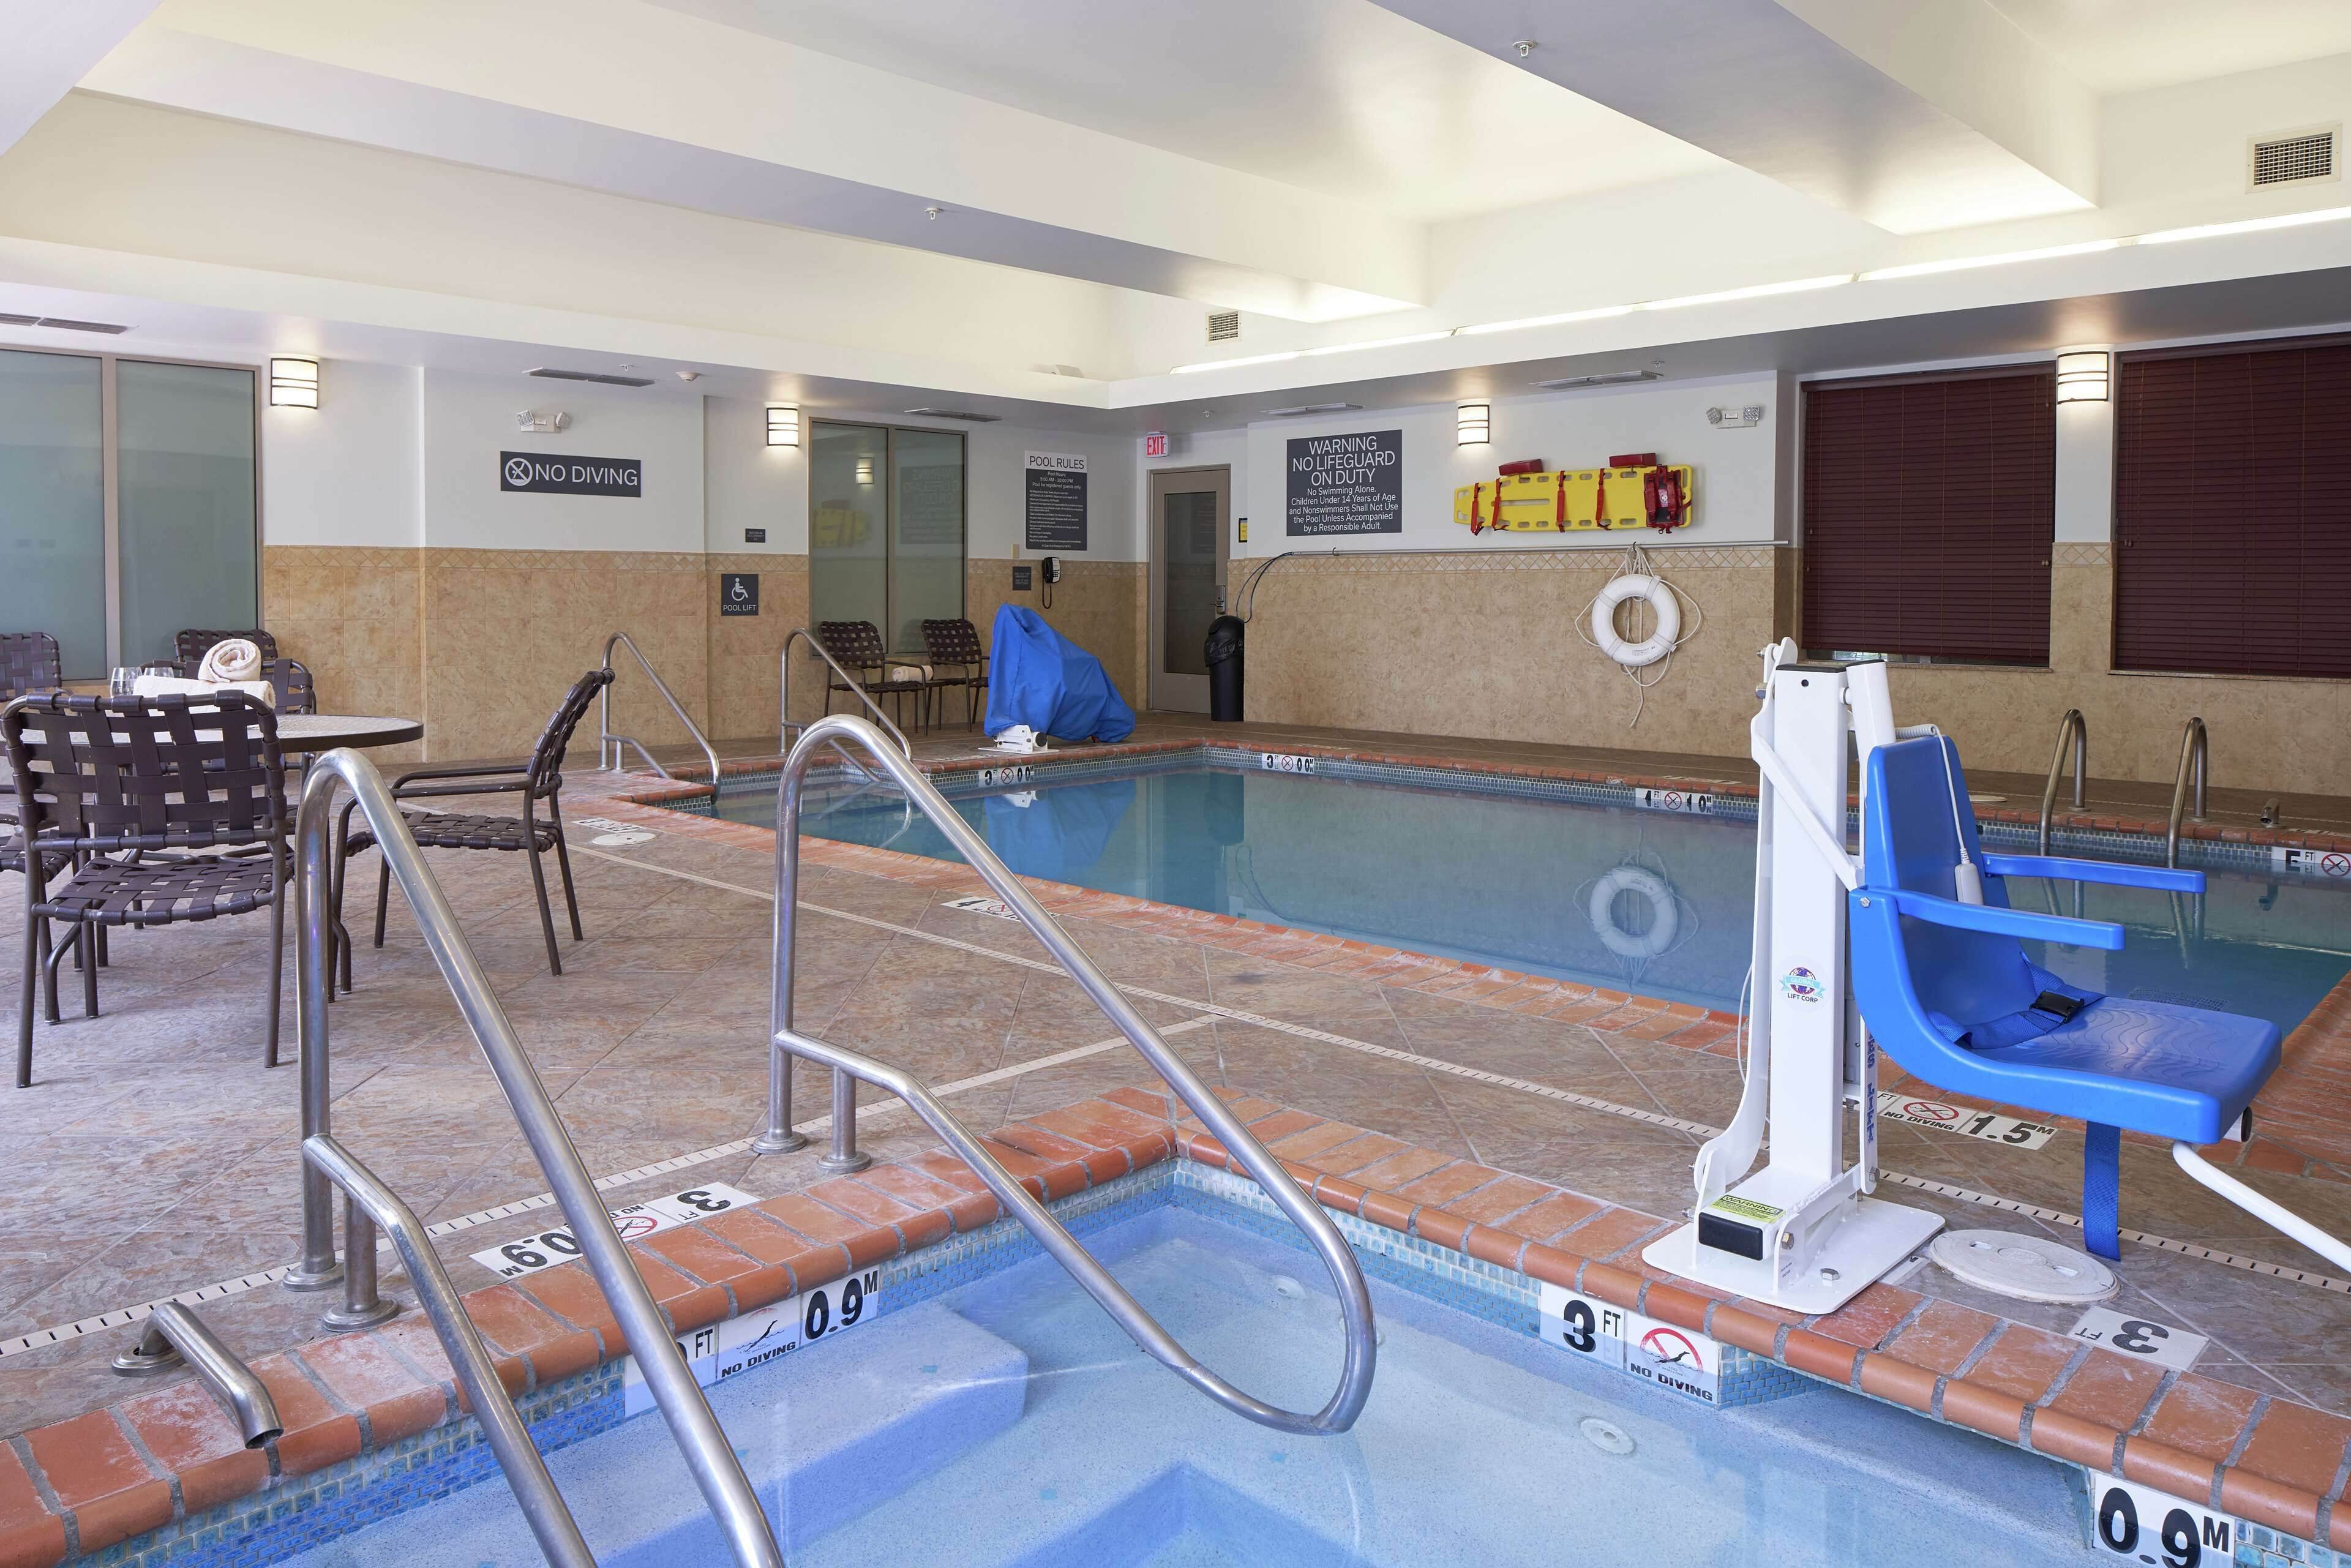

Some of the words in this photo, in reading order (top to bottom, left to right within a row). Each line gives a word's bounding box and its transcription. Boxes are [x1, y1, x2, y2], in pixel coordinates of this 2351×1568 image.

[1147, 435, 1164, 456] EXIT
[1308, 435, 1377, 455] WARNING
[1030, 456, 1055, 467] POOL
[1057, 458, 1084, 469] RULES
[1293, 457, 1313, 472] NO
[1317, 451, 1395, 470] LIFEGUARD
[535, 463, 566, 482] NO
[572, 465, 637, 486] DIVING
[1311, 471, 1332, 486] ON
[1335, 468, 1376, 485] DUTY
[1318, 486, 1353, 496] Swimming
[1354, 485, 1377, 493] Alone.
[1291, 497, 1318, 506] Children
[1319, 495, 1340, 505] Under
[1352, 494, 1371, 503] Years
[1381, 493, 1396, 503] Age
[1289, 506, 1301, 515] and
[1303, 505, 1350, 514] Nonswimmers
[1351, 503, 1368, 512] Shall
[1370, 503, 1383, 511] Not
[1385, 502, 1398, 511] Use
[1305, 514, 1321, 523] Pool
[1322, 514, 1344, 522] Unless
[1346, 512, 1393, 522] Accompanied
[1303, 524, 1311, 533] by
[1319, 522, 1360, 532] Responsible
[1361, 522, 1382, 530] Adult.
[2305, 852, 2314, 861] FT
[1791, 977, 1815, 986] GLOBAL
[1907, 1116, 1955, 1130] DIVING
[677, 1191, 731, 1212] 3
[1726, 1196, 1777, 1213] WARNING
[621, 1205, 645, 1214] NO
[678, 1210, 700, 1220] FT
[1563, 1299, 1597, 1352] 3
[1603, 1310, 1621, 1338] FT
[2074, 1327, 2103, 1341] FT
[2112, 1321, 2169, 1354] 3
[696, 1329, 713, 1358] FT
[722, 1363, 741, 1378] NO
[748, 1341, 796, 1367] DIVING
[1630, 1363, 1652, 1378] NO
[1658, 1372, 1713, 1401] DIVING
